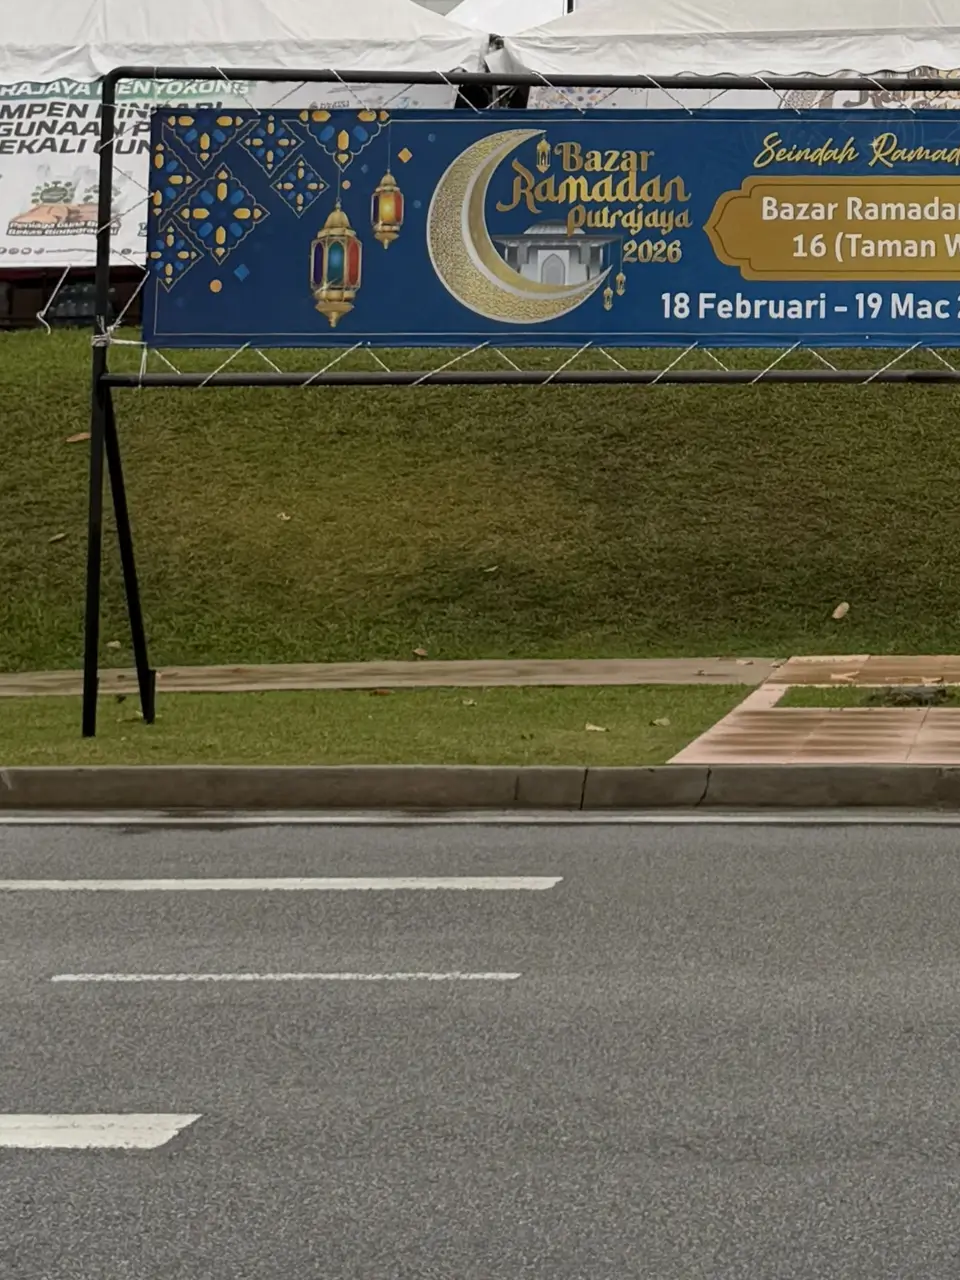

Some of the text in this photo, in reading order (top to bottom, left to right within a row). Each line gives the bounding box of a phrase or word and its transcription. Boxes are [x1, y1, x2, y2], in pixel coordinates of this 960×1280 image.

[96, 79, 249, 96] ENYOKONG
[554, 141, 655, 172] Bazar
[753, 132, 859, 168] Seindah
[495, 158, 692, 214] Ramadan
[762, 196, 839, 221] Bazar
[622, 239, 682, 263] 2026
[793, 233, 827, 257] 16
[835, 231, 936, 262] (Taman
[661, 292, 690, 319] 18
[698, 292, 826, 319] Februari
[855, 292, 883, 319] 19
[891, 292, 950, 319] Mac
